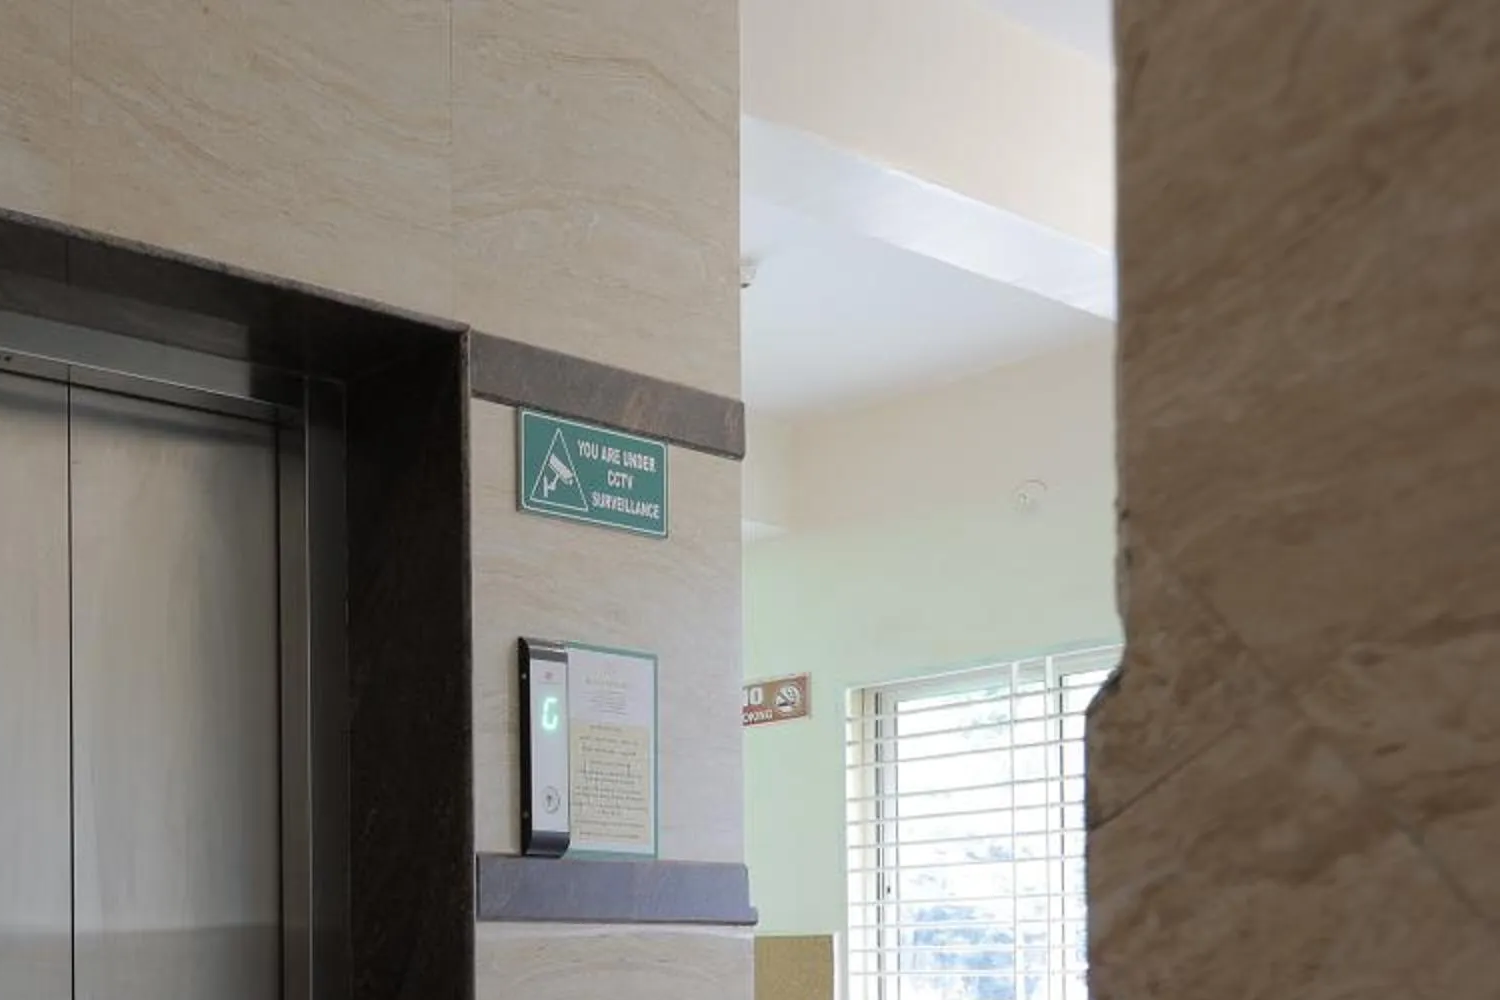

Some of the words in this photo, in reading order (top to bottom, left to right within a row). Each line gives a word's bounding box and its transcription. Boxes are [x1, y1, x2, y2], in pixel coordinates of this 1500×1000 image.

[577, 438, 599, 459] YOU
[601, 446, 621, 465] ARE
[623, 451, 657, 473] UNDER
[607, 469, 635, 490] CCTV
[591, 491, 661, 519] SURVEILLANCE
[541, 697, 559, 731] G
[741, 709, 773, 723] OKING
